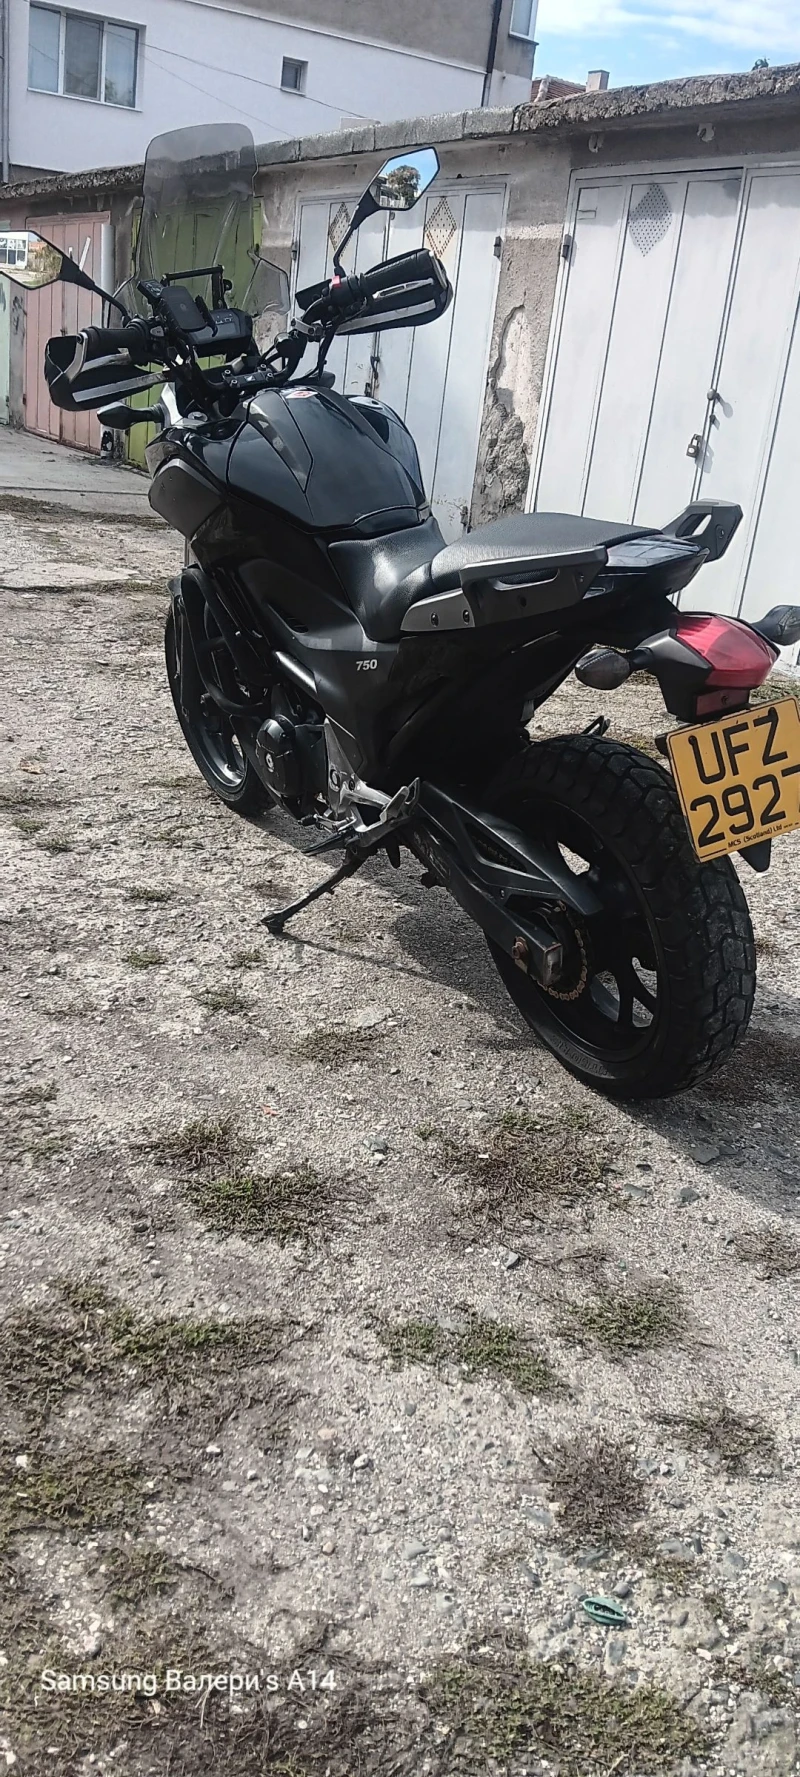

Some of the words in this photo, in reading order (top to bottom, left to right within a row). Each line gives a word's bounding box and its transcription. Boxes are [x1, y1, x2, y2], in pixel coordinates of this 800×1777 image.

[356, 659, 378, 671] 750
[688, 707, 788, 784] UFZ
[728, 838, 741, 847] MCS
[743, 827, 773, 843] (Scotland)
[773, 824, 783, 832] Ltd
